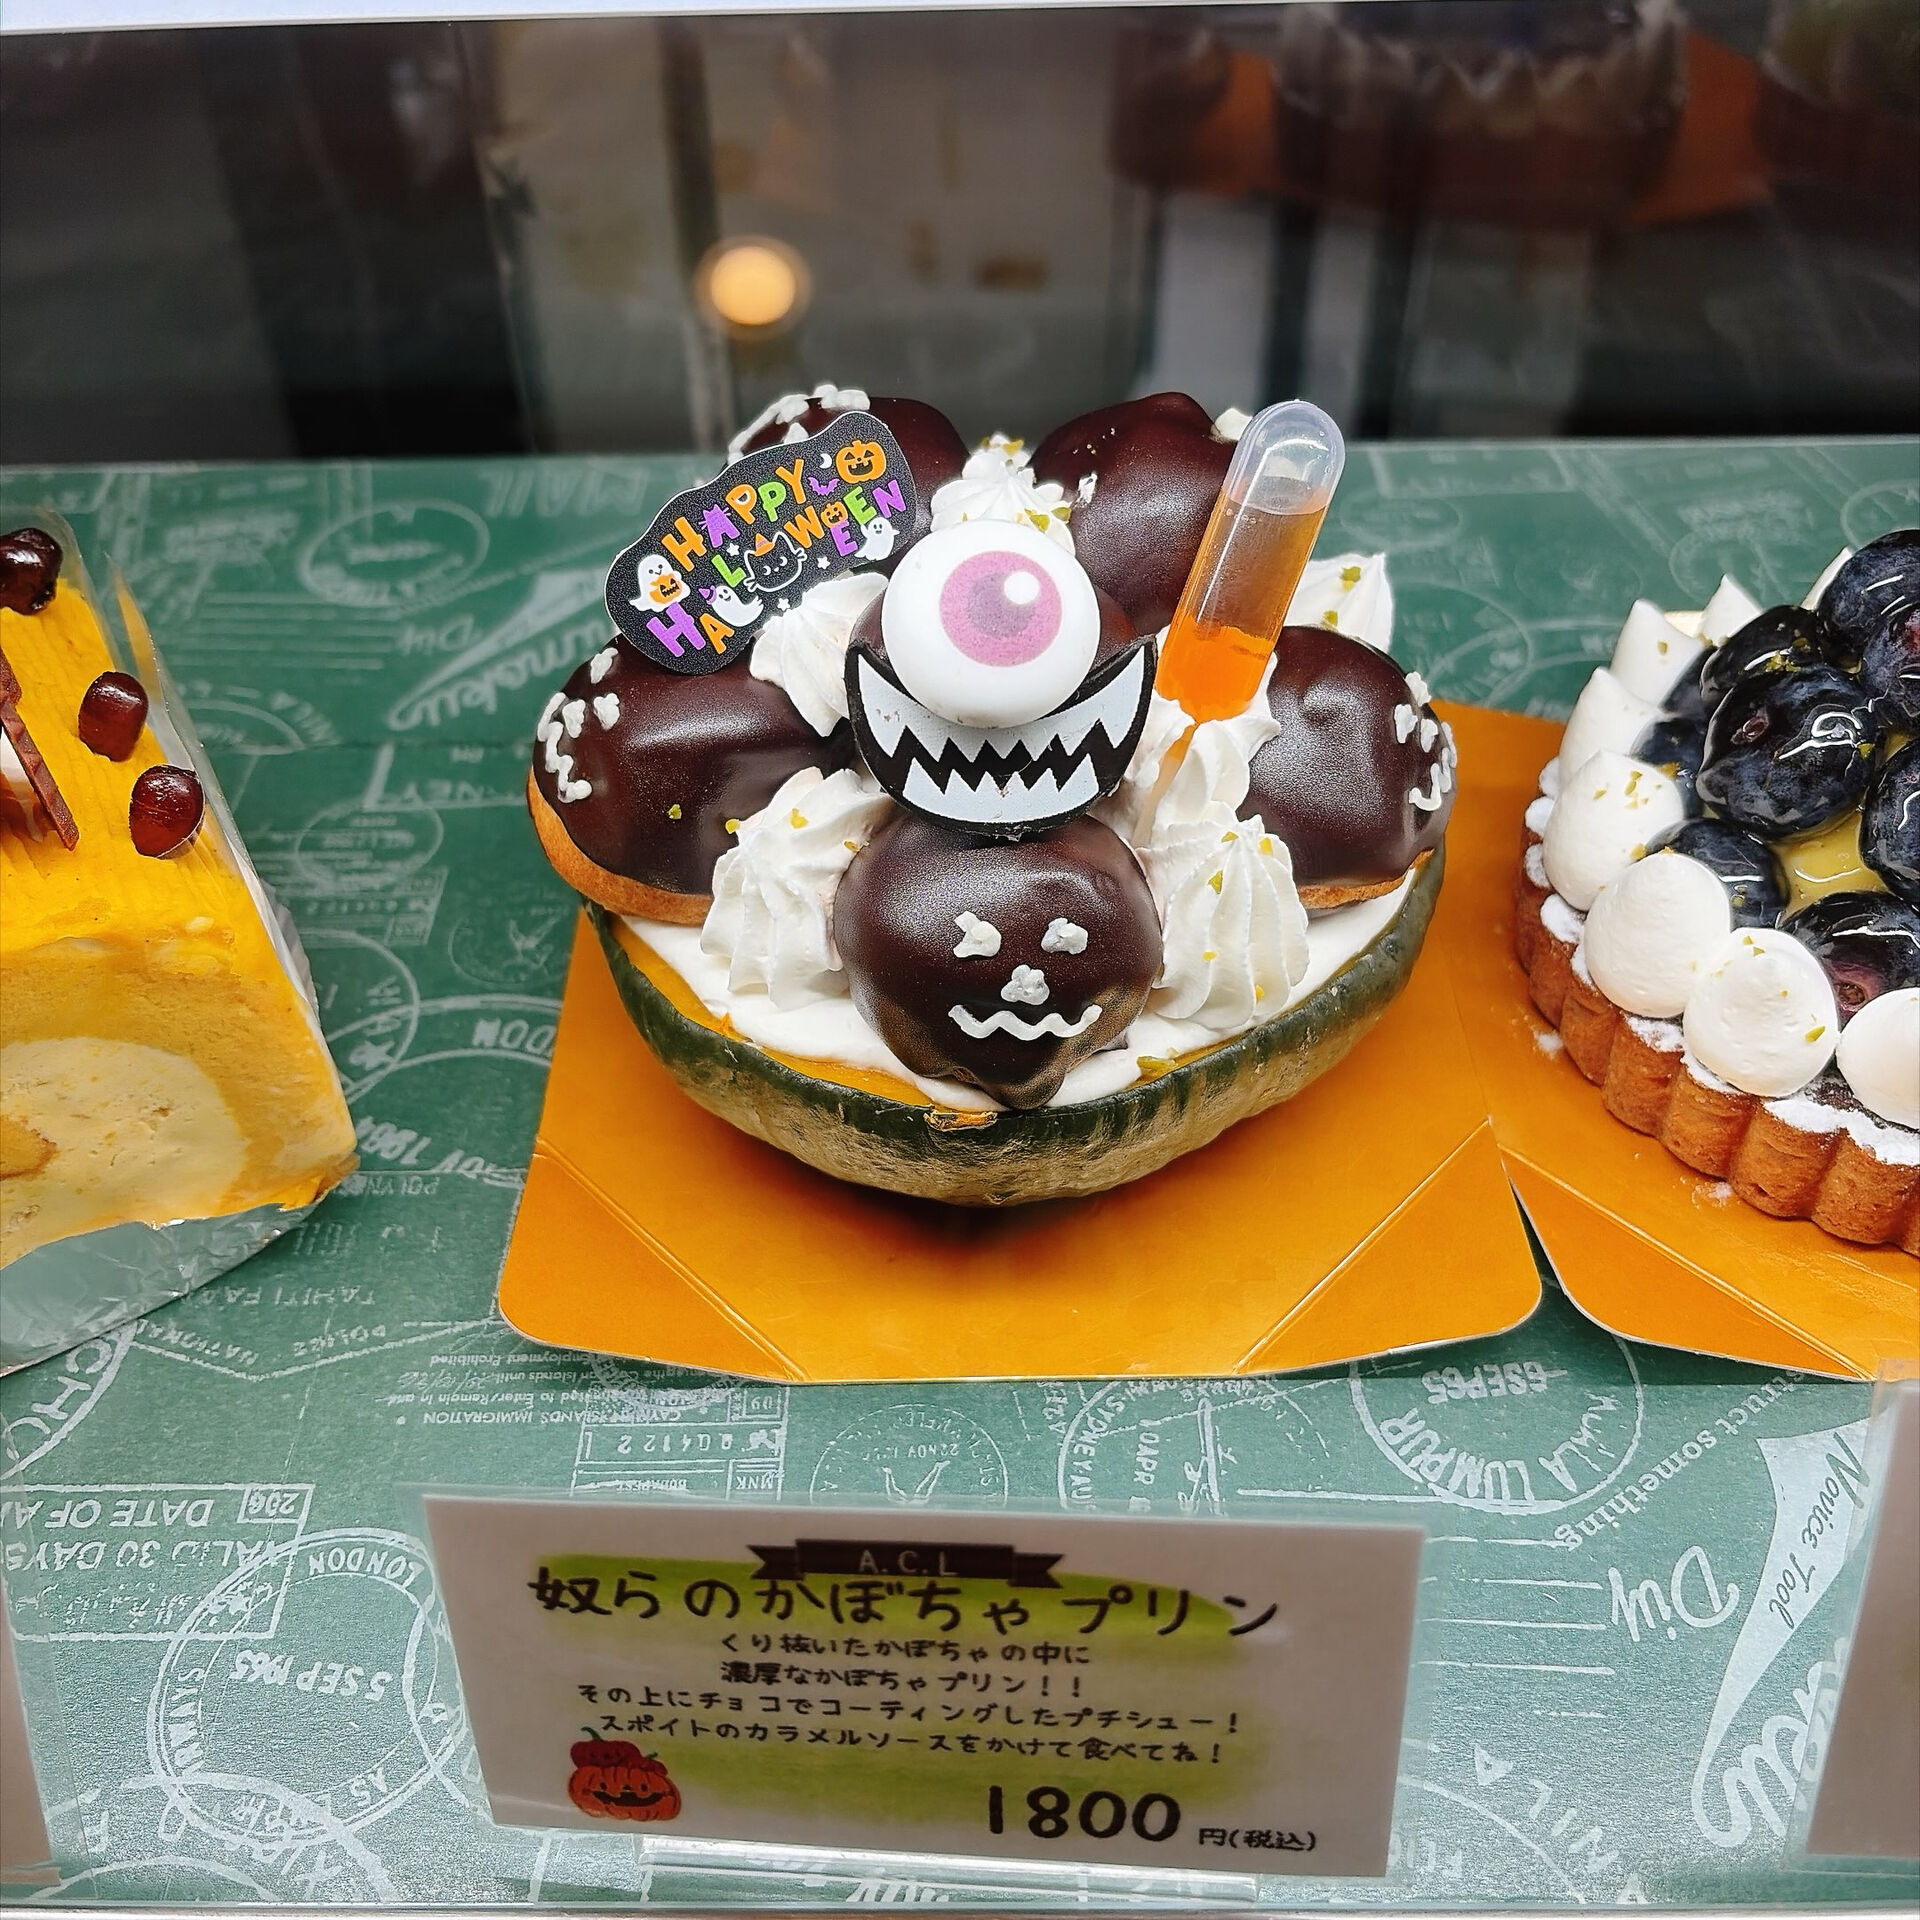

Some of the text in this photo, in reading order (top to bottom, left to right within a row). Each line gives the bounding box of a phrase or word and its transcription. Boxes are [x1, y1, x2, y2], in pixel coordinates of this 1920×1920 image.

[661, 458, 806, 572] HAPPY
[529, 1370, 577, 1384] Islands
[423, 1409, 534, 1426] IMMIGRATION
[1552, 1428, 1718, 1552] something
[1801, 1431, 1871, 1549] Novice
[45, 1498, 104, 1529] OF
[110, 1498, 216, 1528] DATE
[2, 1540, 108, 1573] DAYS
[308, 1546, 426, 1590] LONDON
[720, 1632, 1091, 1665] くり抜いたかぼちゃの中に
[988, 1784, 1182, 1843] 1800
